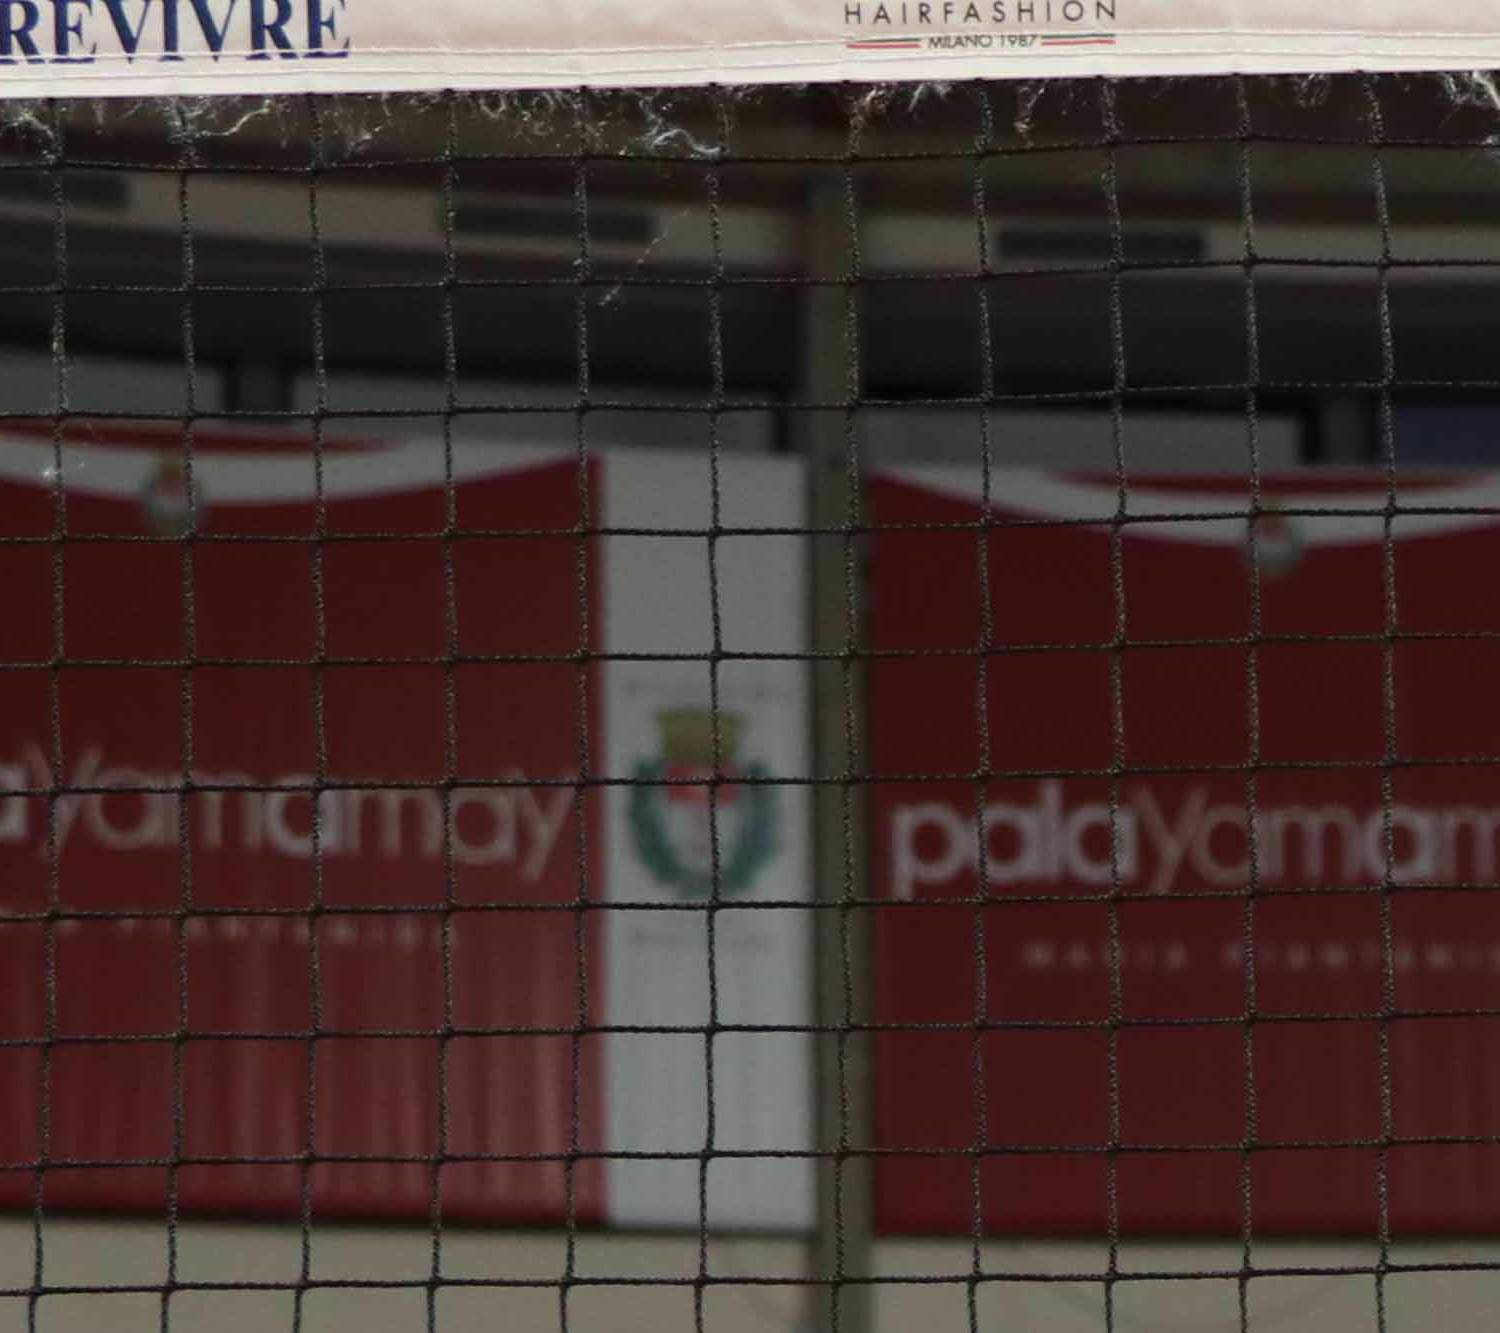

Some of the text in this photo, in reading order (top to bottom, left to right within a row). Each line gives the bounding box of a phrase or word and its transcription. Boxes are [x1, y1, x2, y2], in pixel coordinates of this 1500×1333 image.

[844, 0, 1116, 24] HAIRFASHION
[927, 33, 1038, 49] MILANO 1987
